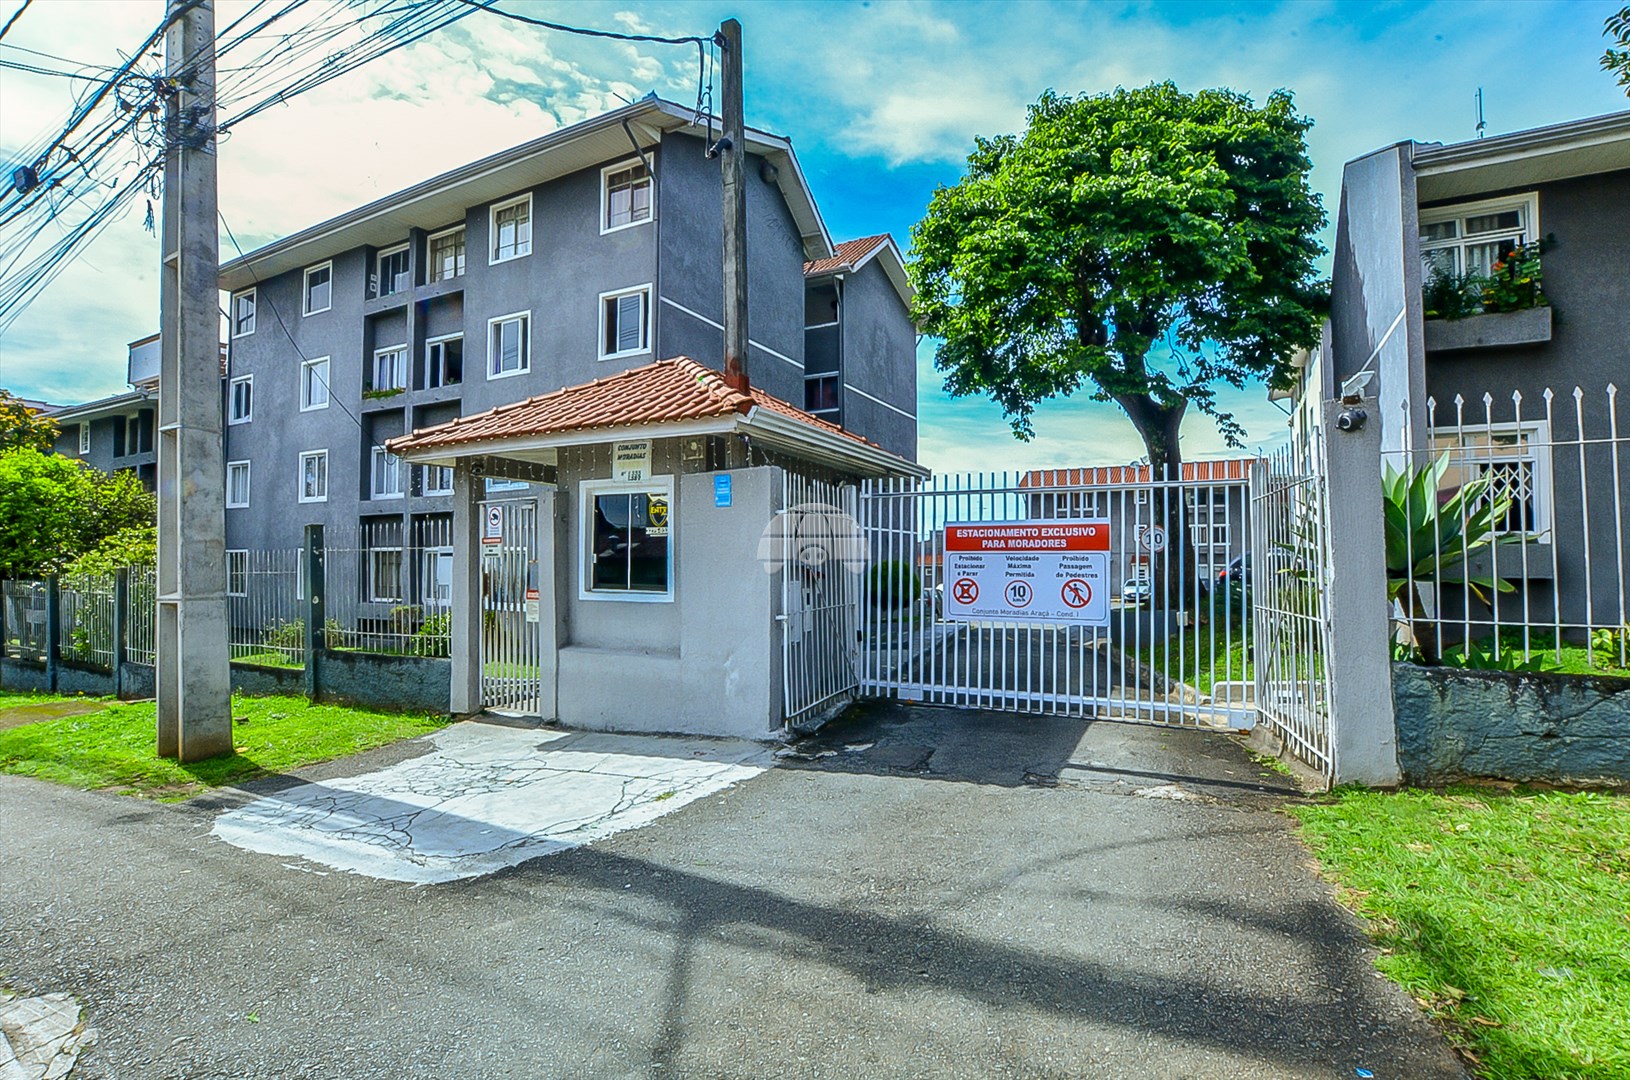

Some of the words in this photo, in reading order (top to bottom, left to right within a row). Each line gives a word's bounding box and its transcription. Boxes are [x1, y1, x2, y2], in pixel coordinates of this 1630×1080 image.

[956, 528, 1039, 538] ESTACIONAMENTO
[1041, 527, 1096, 536] EXCLUSIVO
[982, 540, 1006, 548] PARA
[1008, 539, 1067, 548] MORADORES
[1146, 534, 1162, 544] 10
[1010, 585, 1026, 598] 10
